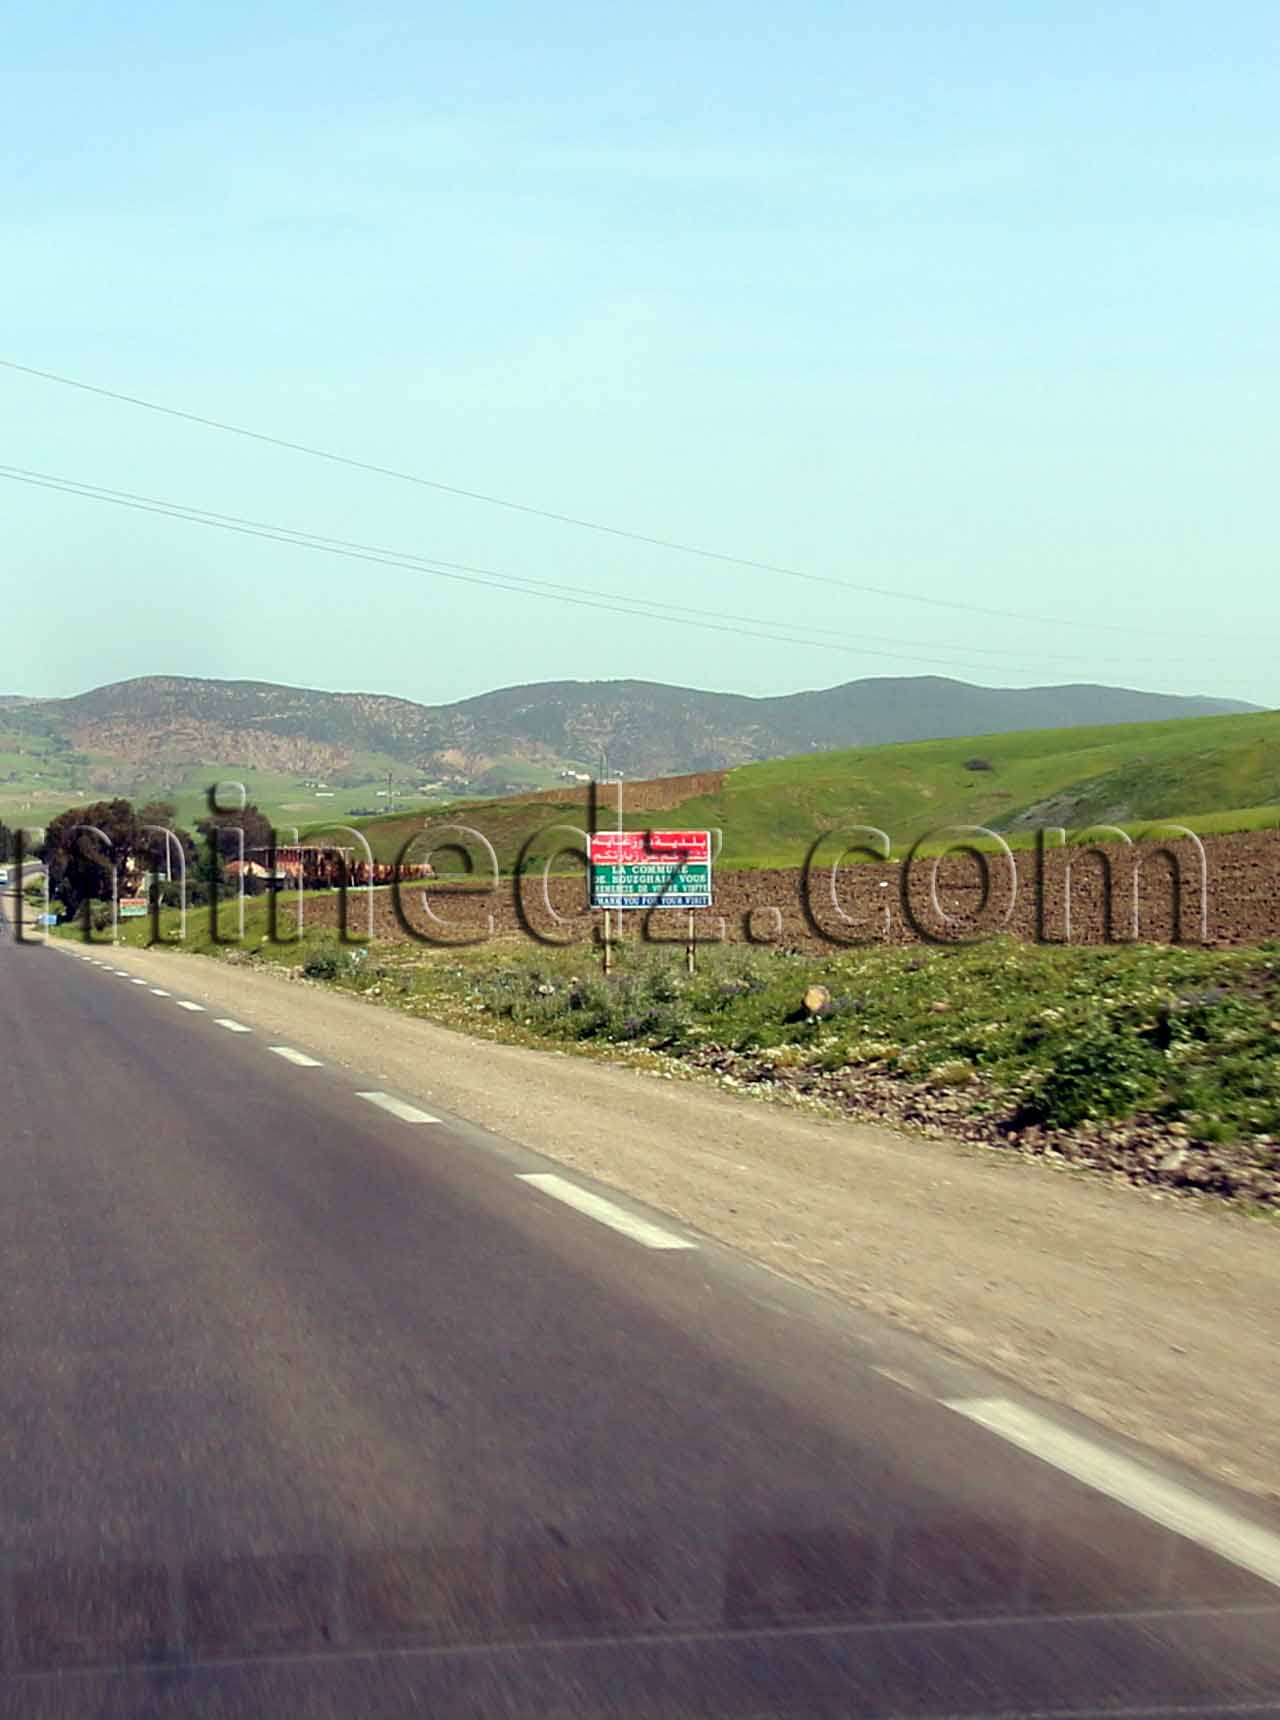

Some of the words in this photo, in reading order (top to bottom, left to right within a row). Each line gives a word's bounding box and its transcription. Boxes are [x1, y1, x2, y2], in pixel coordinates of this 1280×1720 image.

[612, 866, 626, 874] LA
[679, 874, 706, 883] VOUS
[652, 884, 678, 892] VORE
[624, 897, 639, 905] YOU
